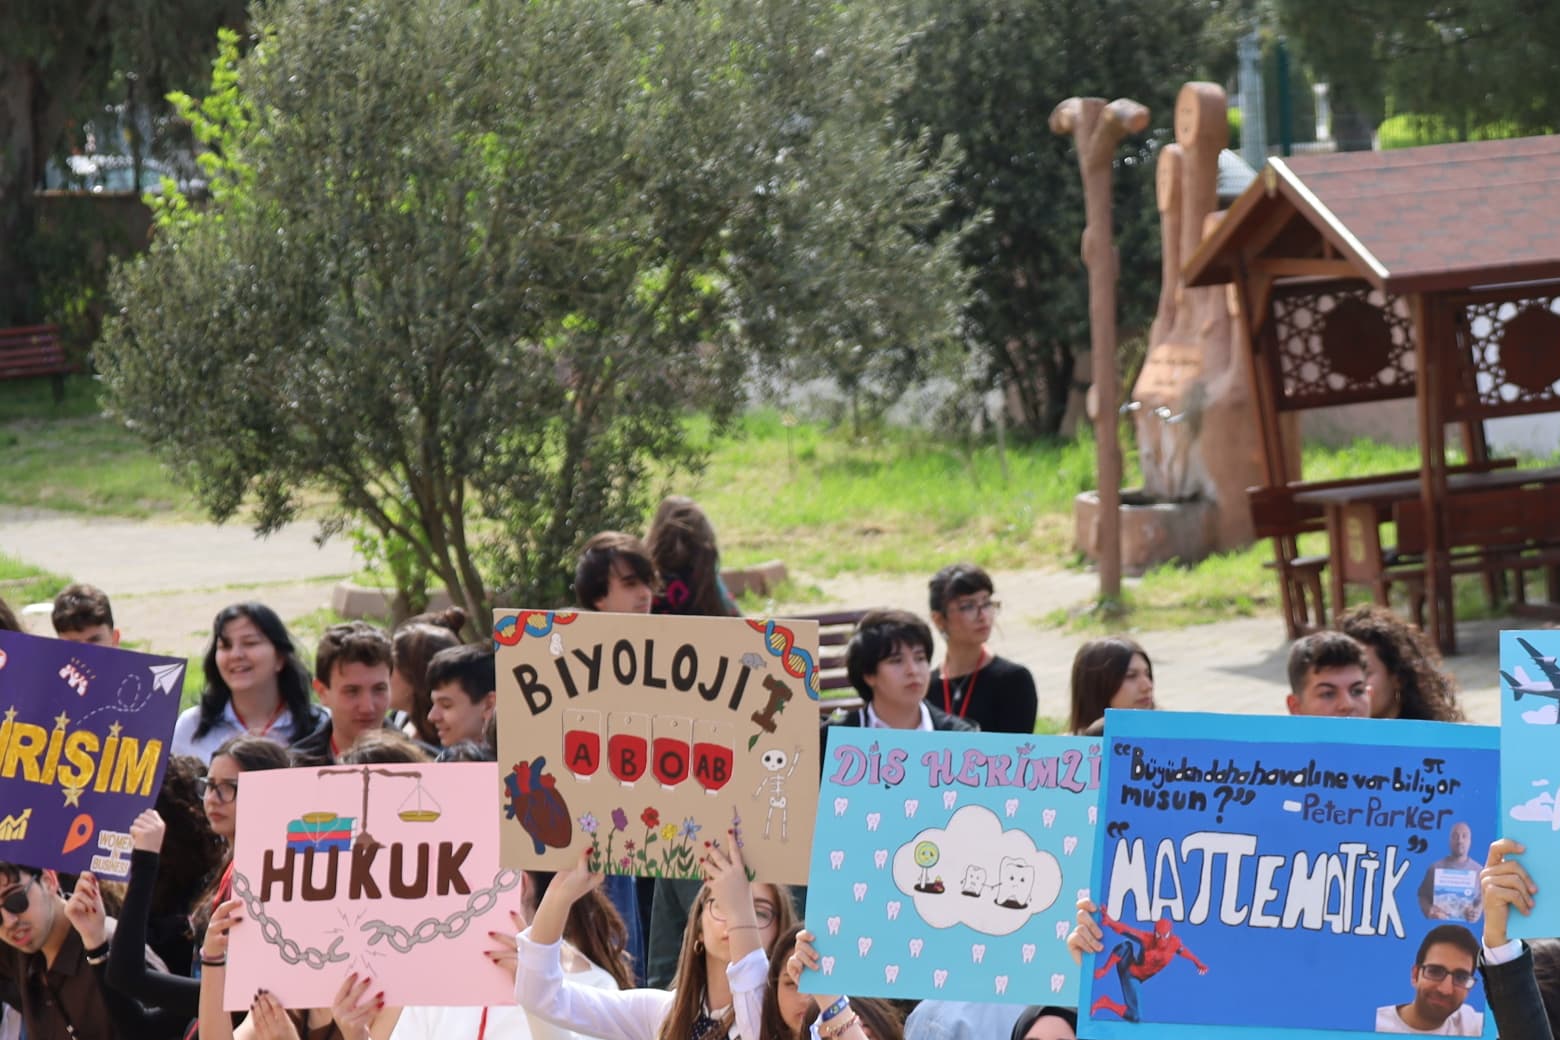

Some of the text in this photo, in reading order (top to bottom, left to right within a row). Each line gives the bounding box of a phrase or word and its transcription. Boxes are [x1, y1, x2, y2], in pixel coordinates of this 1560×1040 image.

[571, 742, 593, 768] A
[620, 748, 637, 777] B
[696, 757, 726, 782] AB
[1322, 770, 1349, 790] ne
[1365, 796, 1455, 831] Parker
[258, 841, 474, 903] HUKUK
